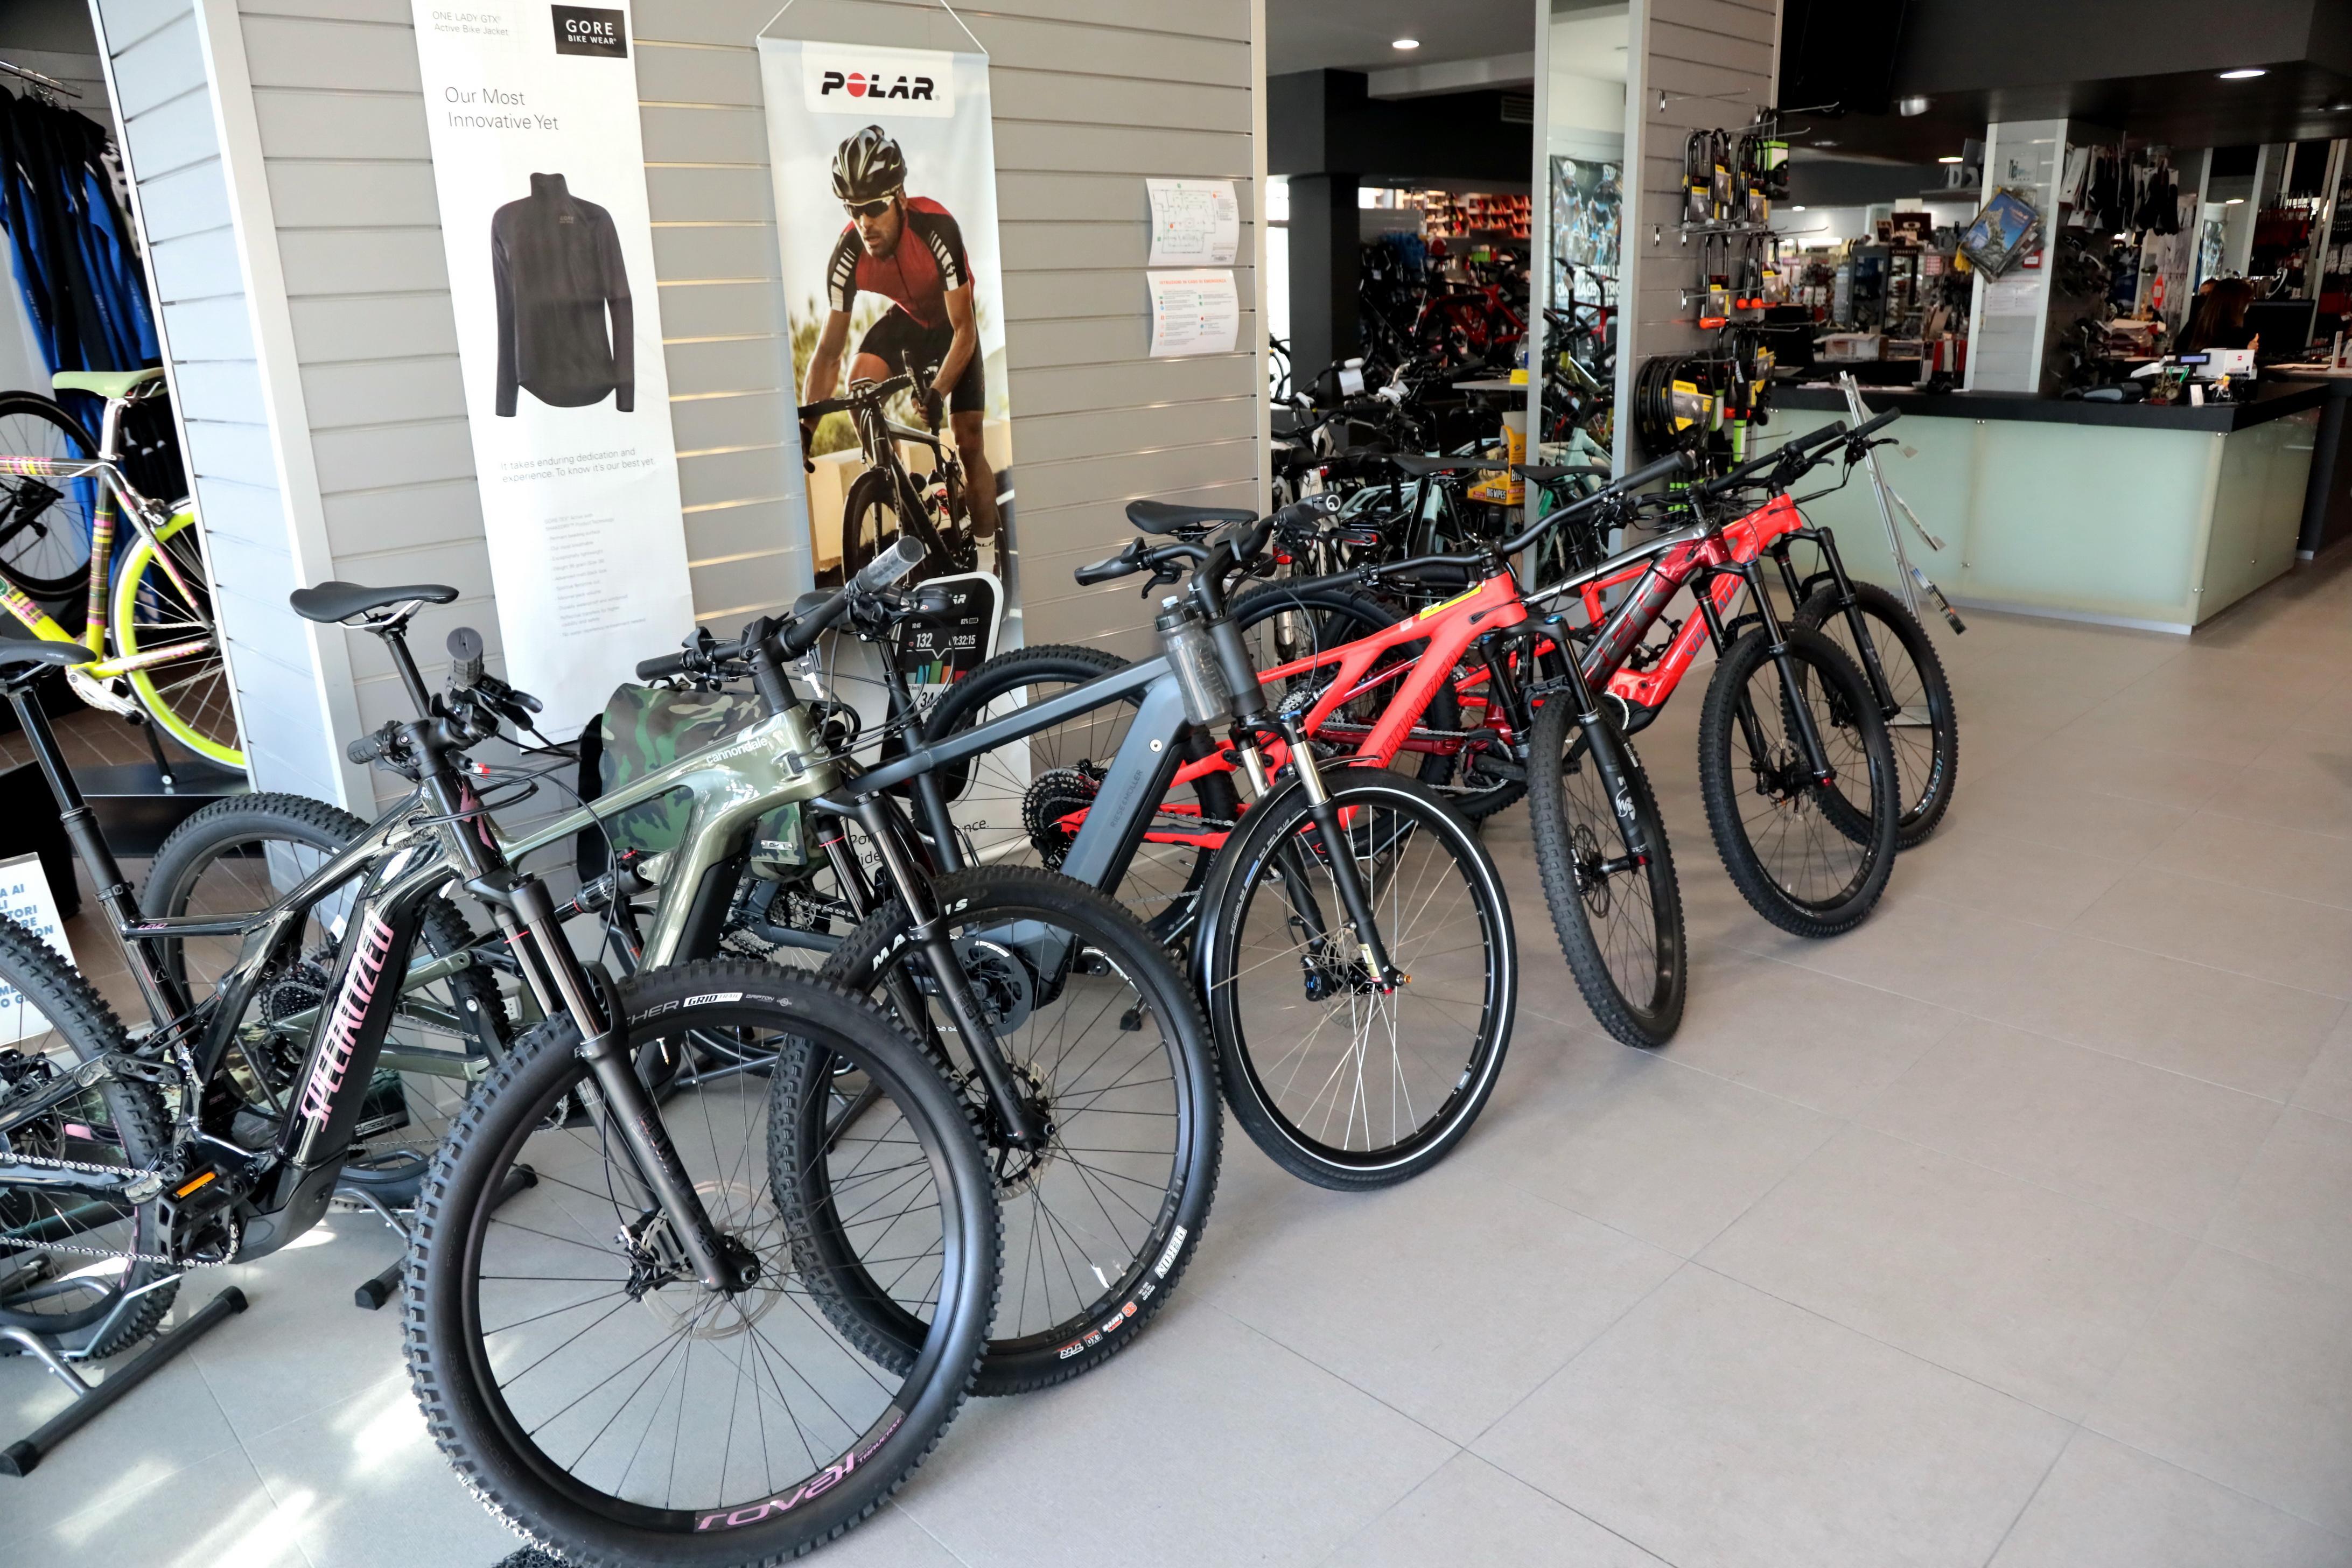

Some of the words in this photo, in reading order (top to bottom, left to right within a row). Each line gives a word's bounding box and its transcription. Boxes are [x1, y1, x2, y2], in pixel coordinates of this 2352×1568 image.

[432, 11, 452, 21] ONE
[455, 12, 478, 23] LADY
[435, 23, 460, 33] Active
[463, 25, 480, 34] Bike
[483, 26, 509, 36] Jacket
[565, 19, 614, 36] GORE
[568, 35, 587, 43] BIKE
[821, 71, 934, 101] POLAR
[445, 87, 476, 103] Our
[484, 89, 526, 106] Most
[449, 112, 531, 130] Innovative
[535, 115, 558, 130] Yet
[510, 460, 535, 470] takes
[537, 456, 575, 467] enduring
[576, 450, 618, 462] dedication
[620, 447, 635, 457] and
[556, 467, 565, 477] To
[568, 466, 591, 475] know
[606, 463, 620, 471] our
[622, 459, 640, 468] best
[1494, 489, 1506, 499] WIPES
[916, 632, 933, 648] 132
[706, 737, 768, 764] cannondale
[12, 884, 25, 895] AI
[688, 995, 717, 1006] GRID
[300, 909, 394, 1132] SPECIALIZED
[1155, 1225, 1187, 1279] REKON
[1086, 1332, 1102, 1347] EXO
[698, 1452, 854, 1530] roval
[857, 1413, 905, 1464] TRAVERSE
